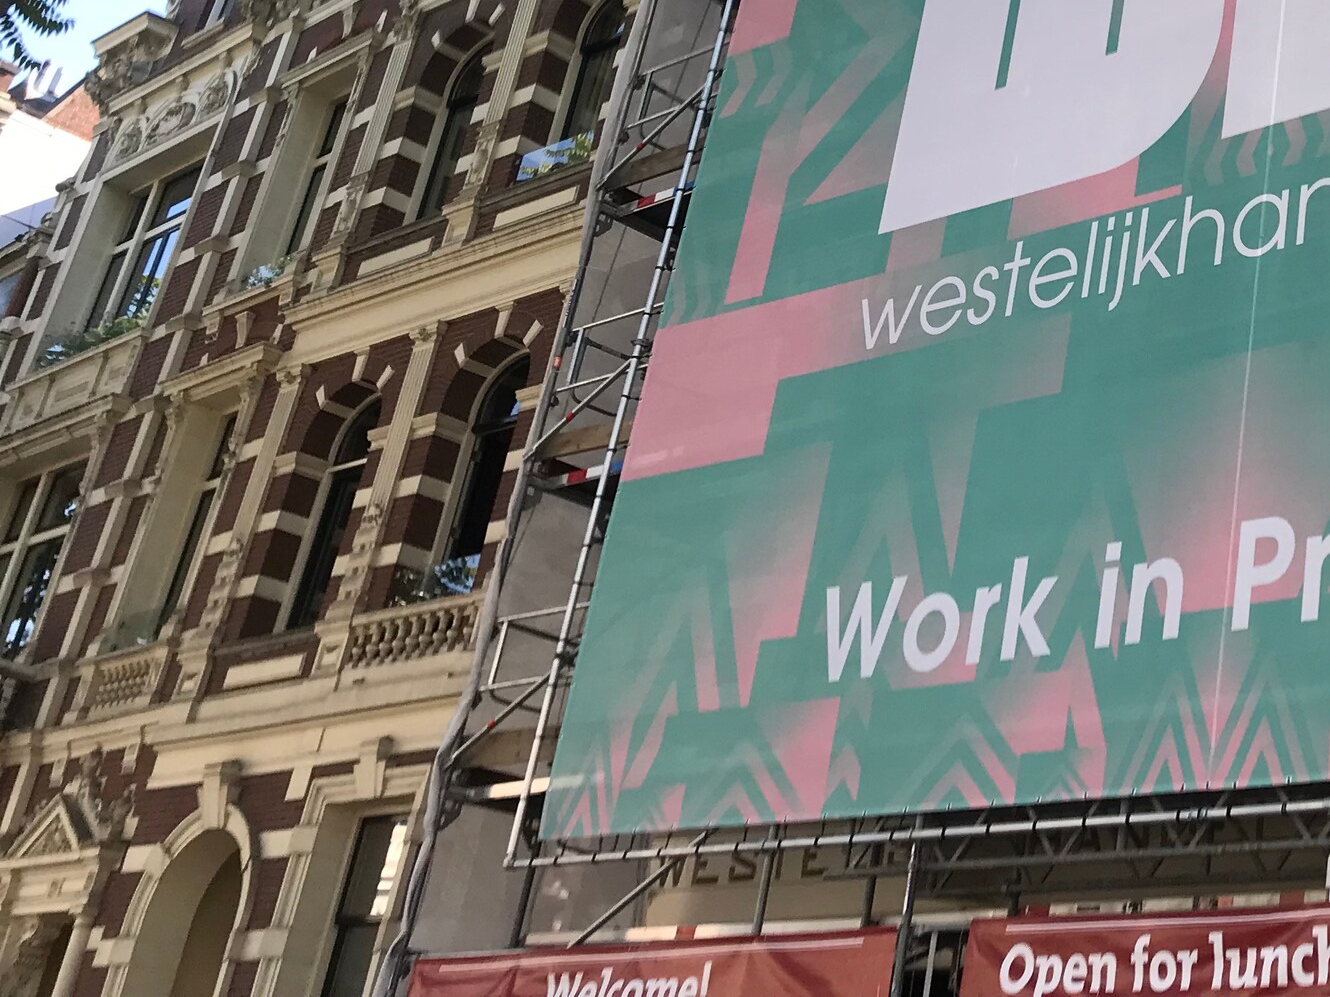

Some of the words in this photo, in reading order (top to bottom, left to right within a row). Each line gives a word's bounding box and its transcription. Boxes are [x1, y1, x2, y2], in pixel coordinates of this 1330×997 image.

[825, 575, 1060, 684] Work
[1093, 540, 1185, 650] in
[1000, 941, 1118, 997] Open
[1130, 933, 1199, 994] for
